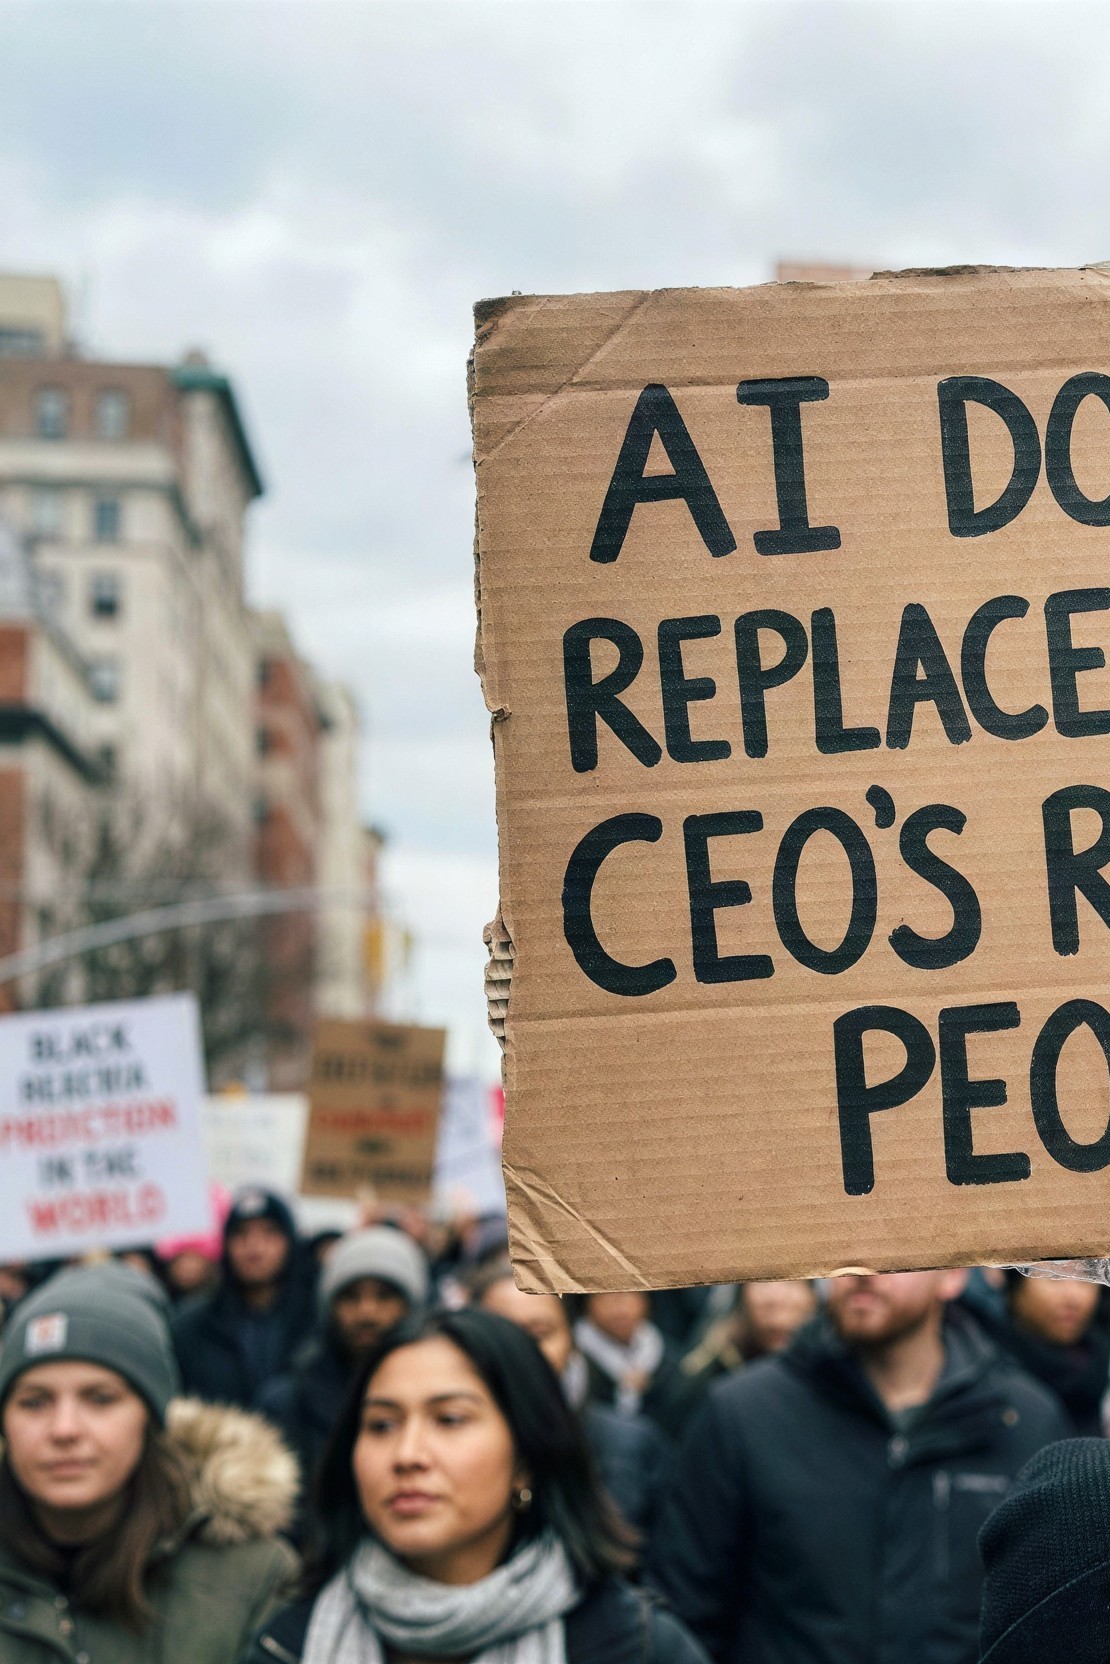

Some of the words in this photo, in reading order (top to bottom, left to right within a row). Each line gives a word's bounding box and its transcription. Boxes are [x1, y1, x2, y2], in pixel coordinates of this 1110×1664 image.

[588, 377, 842, 565] AI
[560, 784, 982, 997] CEO'S
[30, 1023, 131, 1063] BLACK
[28, 1184, 165, 1236] WORLD
